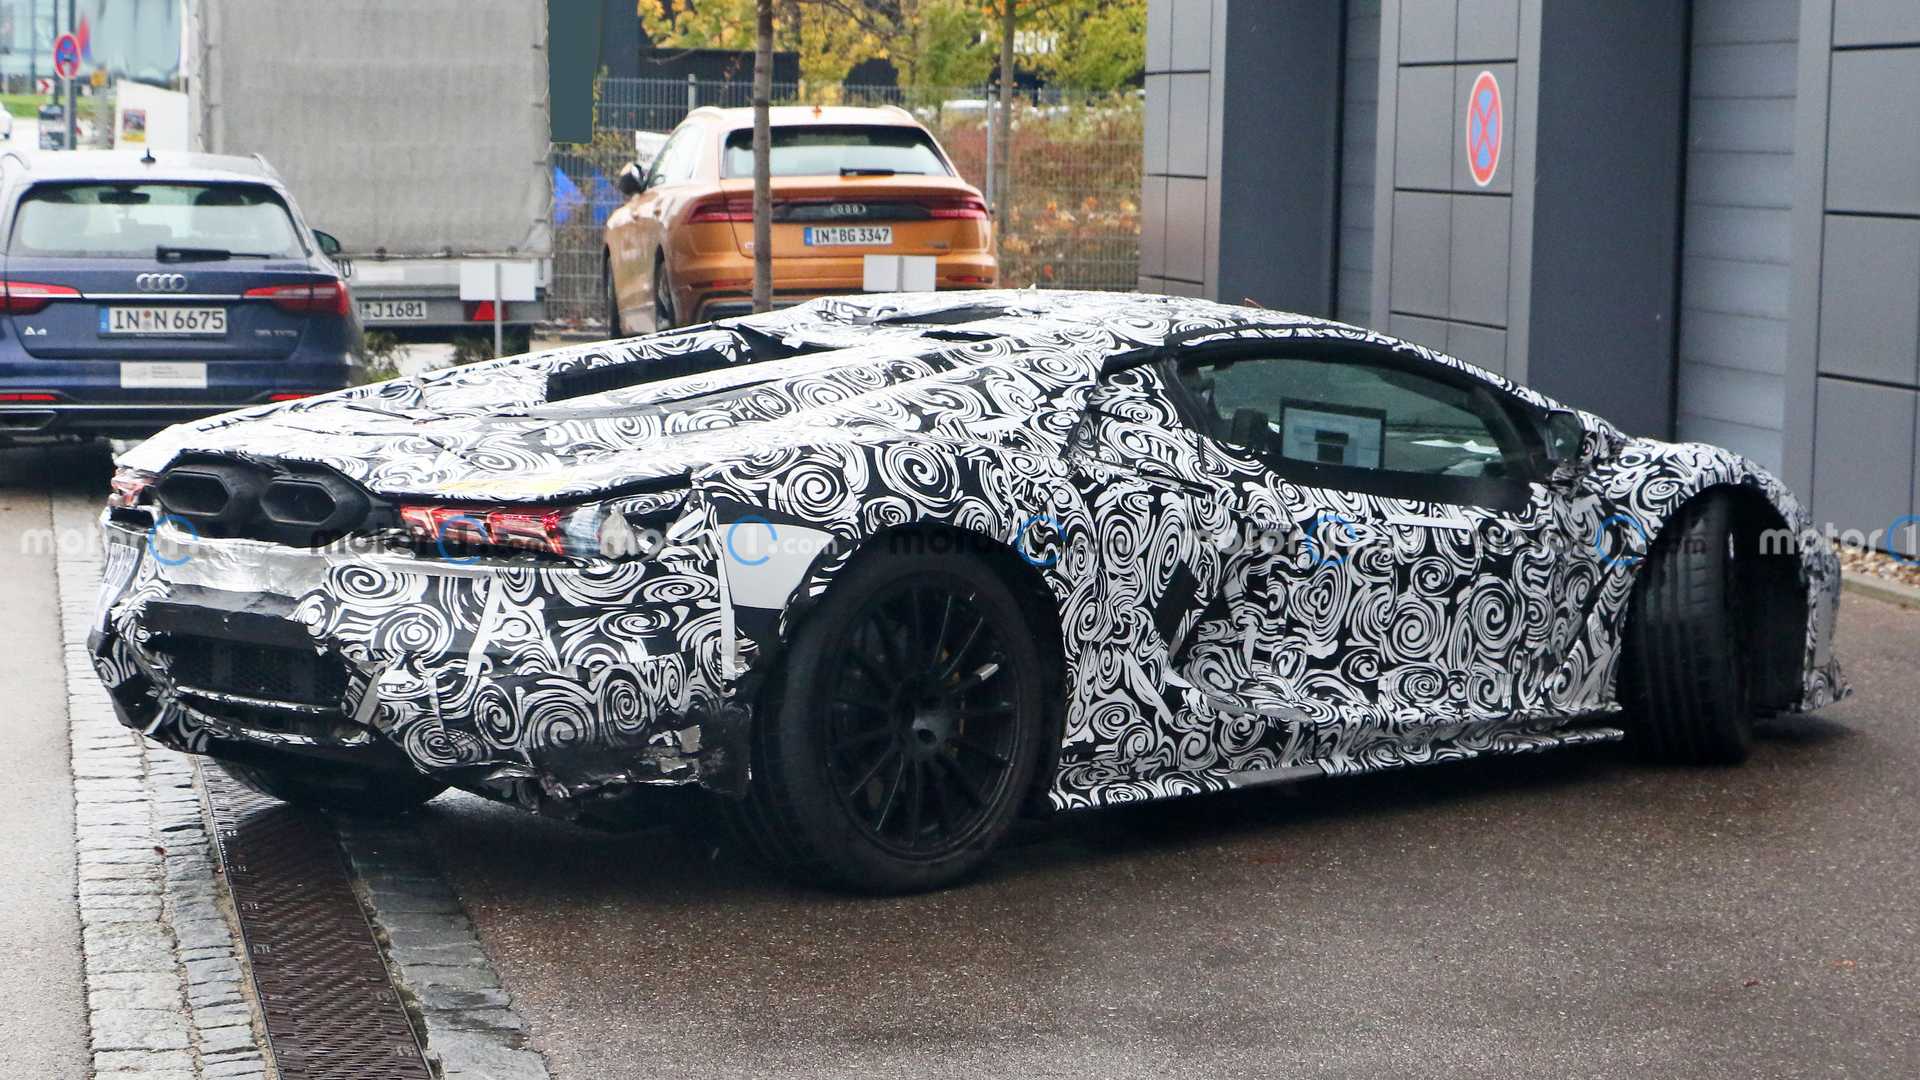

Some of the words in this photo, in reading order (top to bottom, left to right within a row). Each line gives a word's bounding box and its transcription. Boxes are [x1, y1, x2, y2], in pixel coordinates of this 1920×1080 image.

[815, 229, 830, 243] IN
[839, 229, 856, 243] BG
[858, 228, 890, 242] 3347
[114, 310, 140, 330] IN
[154, 310, 167, 330] N
[173, 310, 224, 329] 6675
